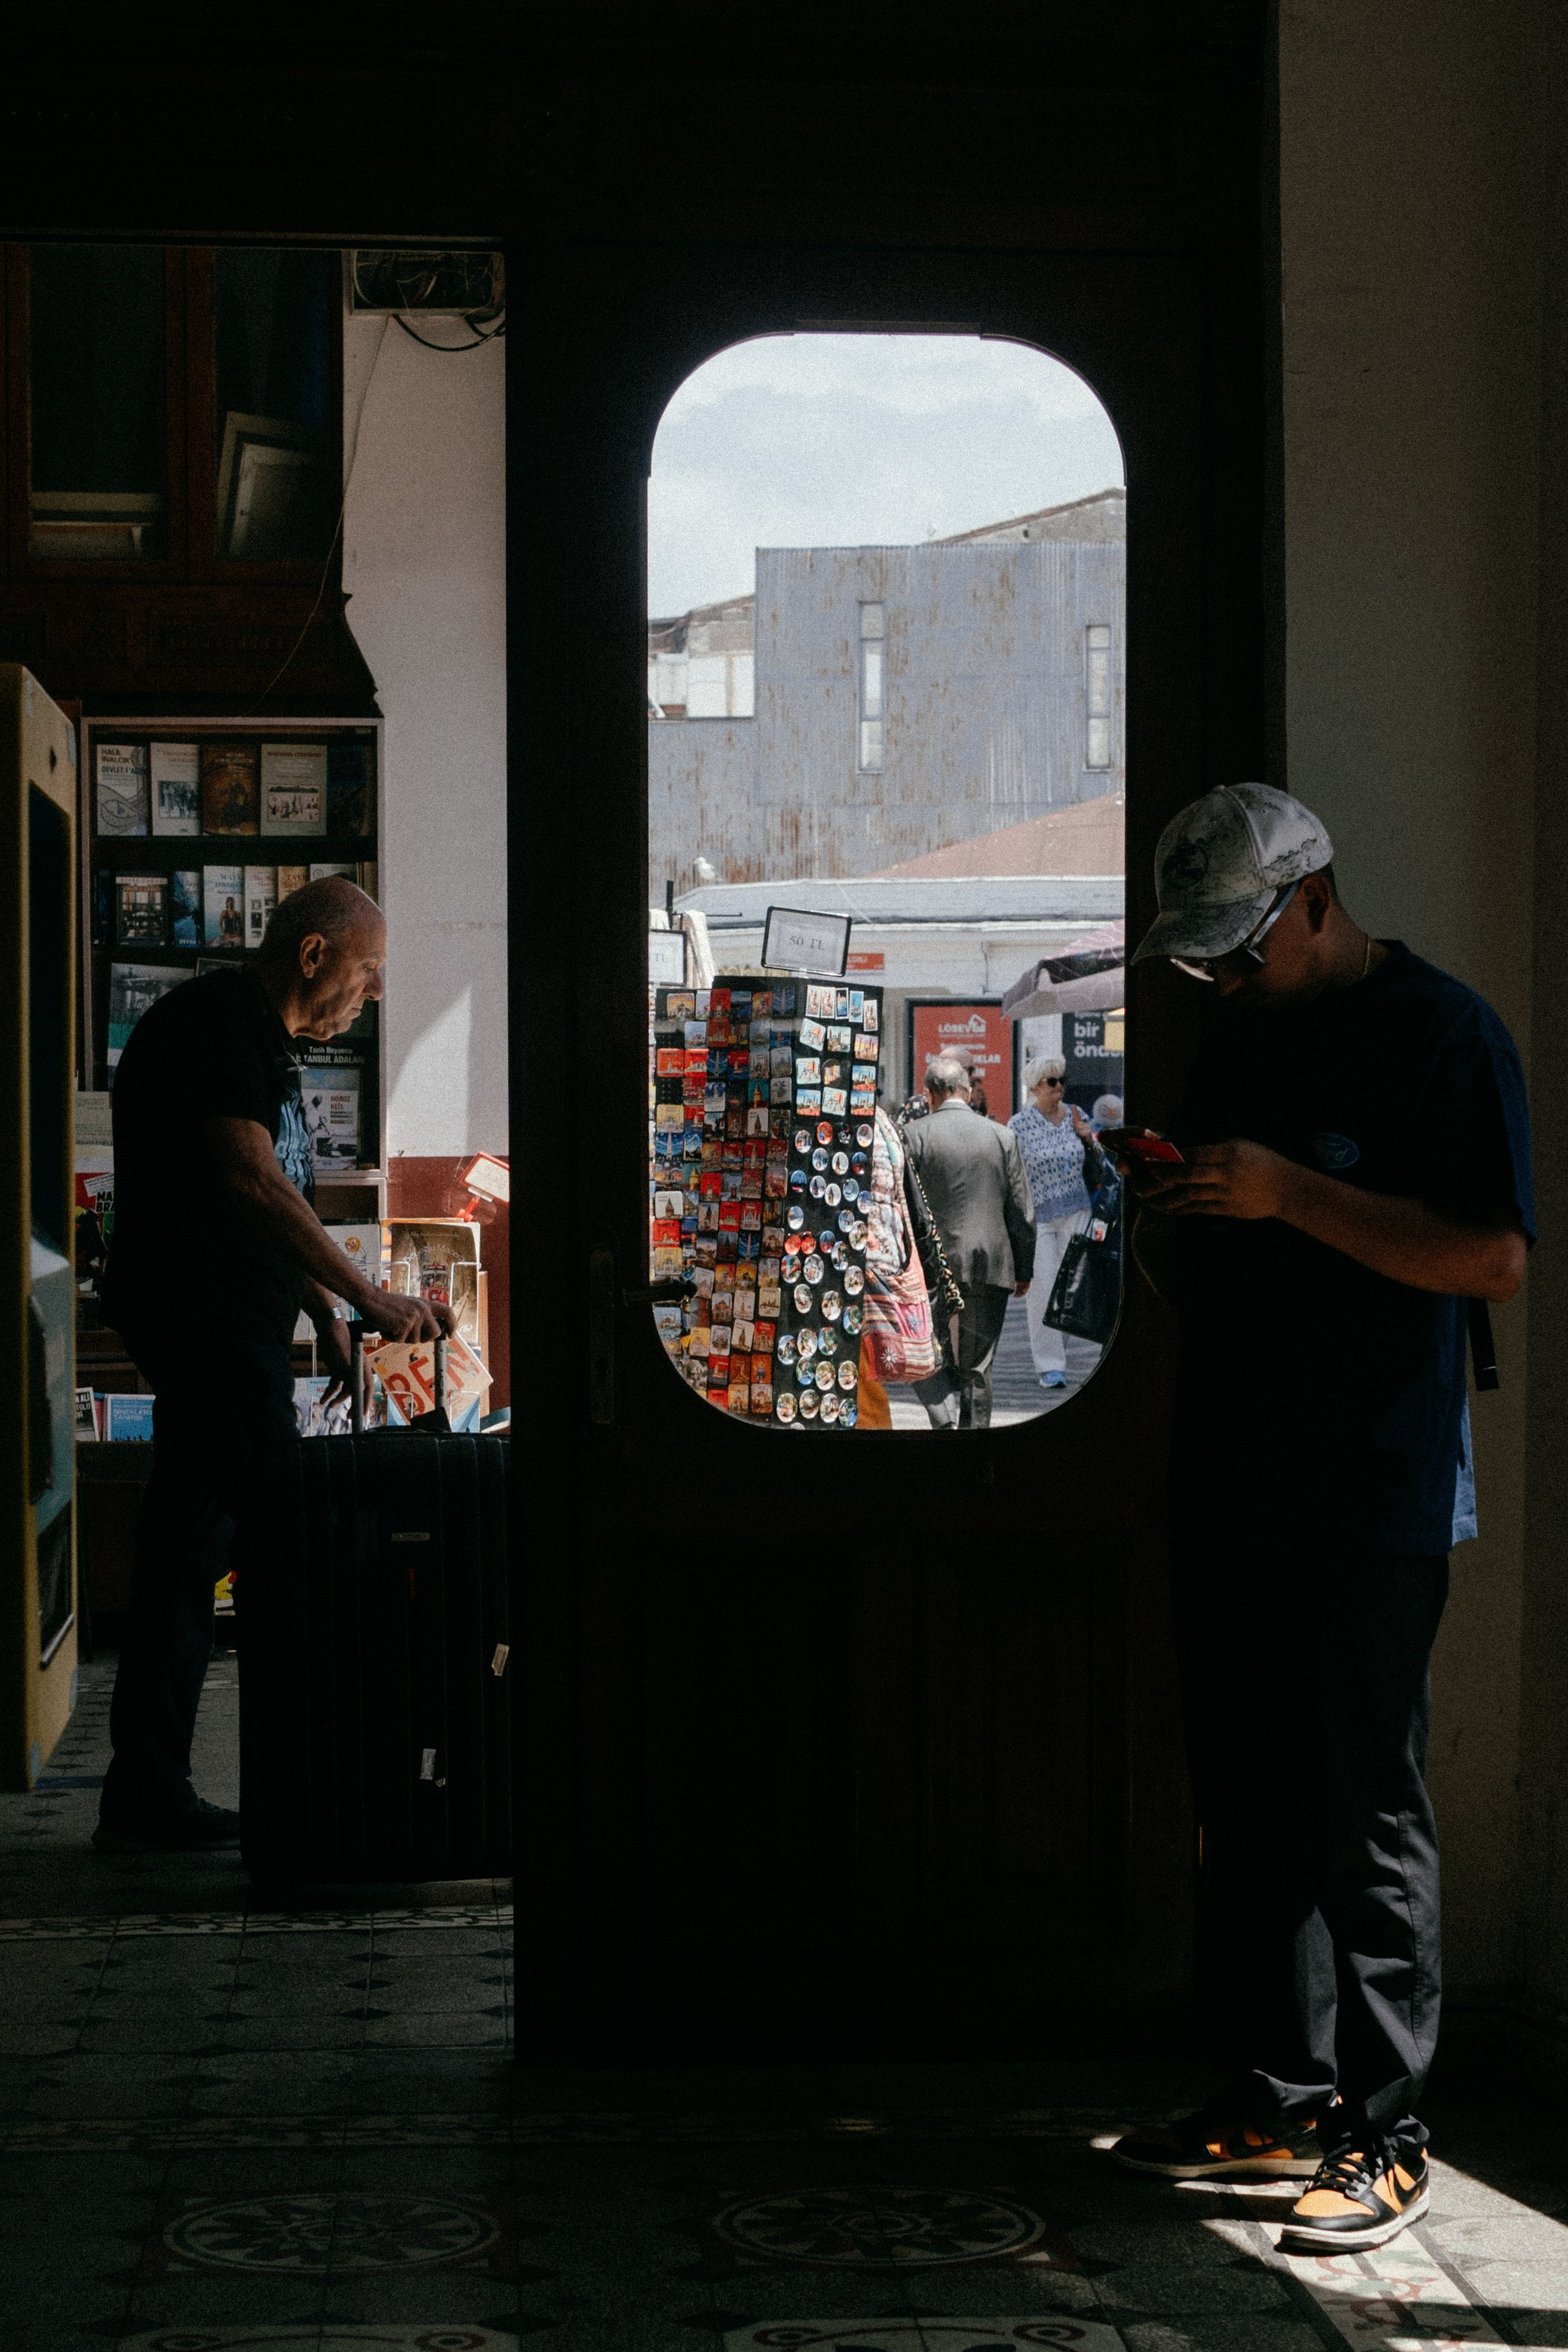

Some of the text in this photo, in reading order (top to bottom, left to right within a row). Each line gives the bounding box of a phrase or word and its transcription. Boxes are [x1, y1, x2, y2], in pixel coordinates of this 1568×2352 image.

[789, 936, 825, 951] 50 TL
[653, 953, 666, 963] TL
[1073, 1021, 1100, 1038] bir
